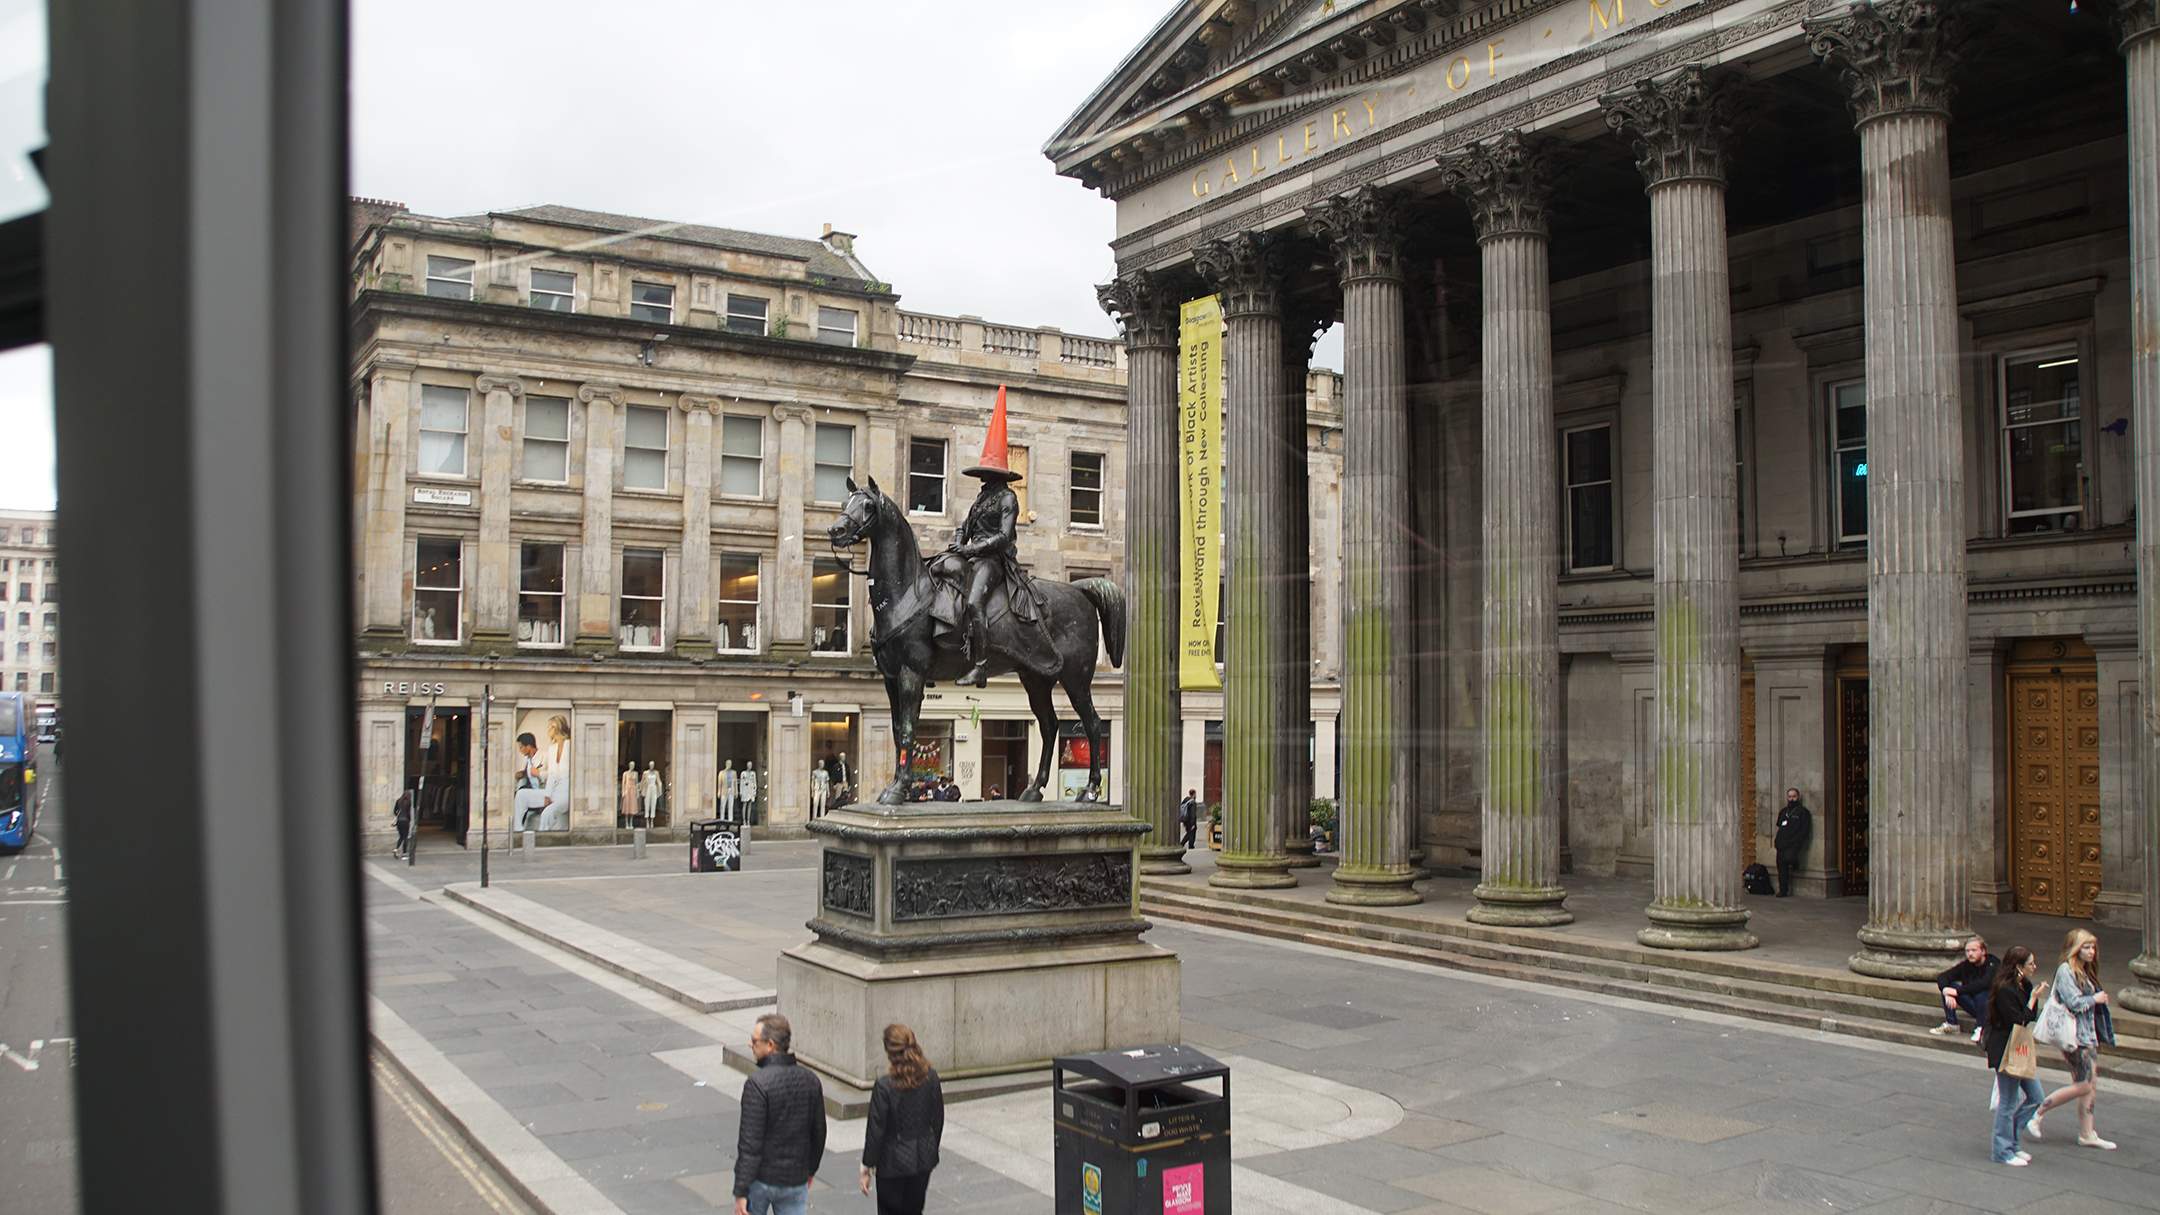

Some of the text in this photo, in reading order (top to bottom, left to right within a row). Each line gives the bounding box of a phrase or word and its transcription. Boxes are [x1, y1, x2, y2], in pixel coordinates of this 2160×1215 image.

[1193, 92, 1380, 198] GALLERY
[1447, 38, 1505, 91] OF
[1187, 344, 1198, 394] Artists
[1200, 341, 1209, 422] Collecting
[1186, 401, 1196, 443] Black
[1186, 450, 1194, 465] of
[1199, 428, 1208, 460] New
[1196, 466, 1210, 530] through
[383, 681, 445, 695] REISS
[1163, 1127, 1178, 1137] DOG
[1178, 1123, 1201, 1134] WASTE
[1168, 1114, 1190, 1125] LITTER
